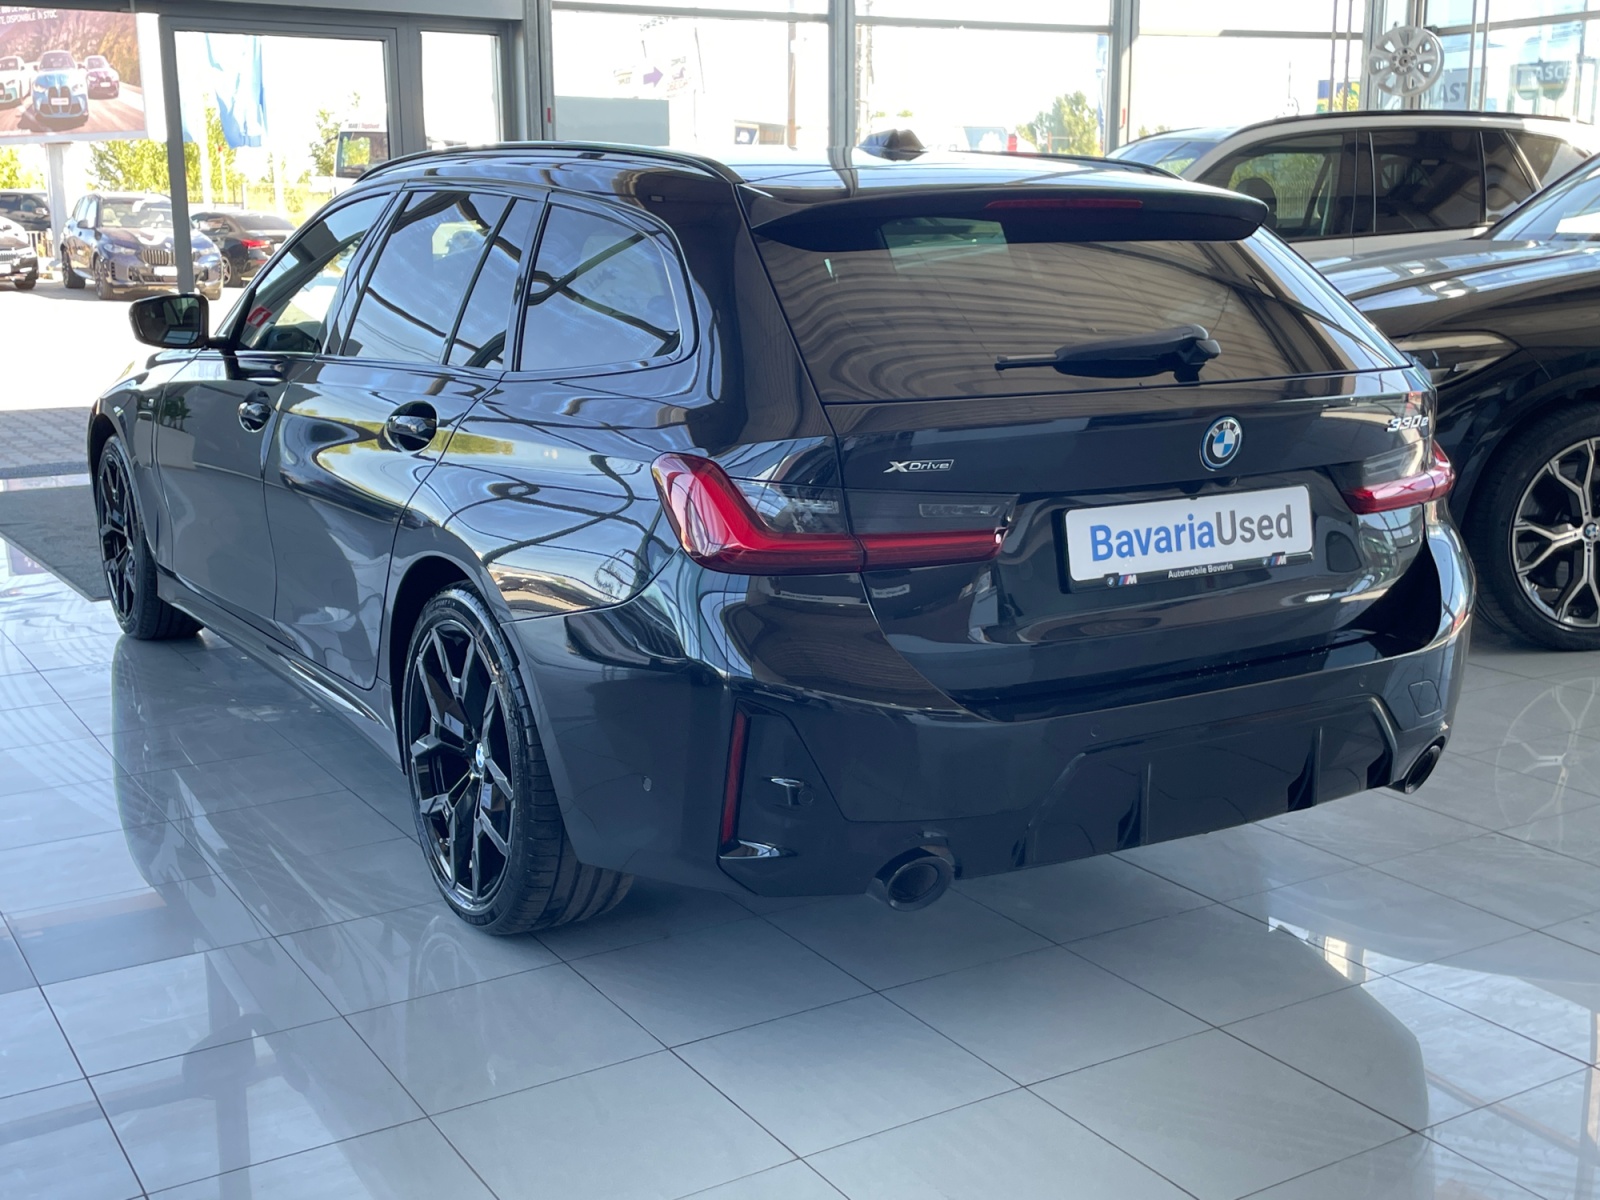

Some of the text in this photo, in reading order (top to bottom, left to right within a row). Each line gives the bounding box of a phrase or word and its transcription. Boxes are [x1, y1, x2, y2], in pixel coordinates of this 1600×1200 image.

[1089, 504, 1294, 562] BavariaUsed
[1167, 562, 1234, 579] Automobile Bavaria
